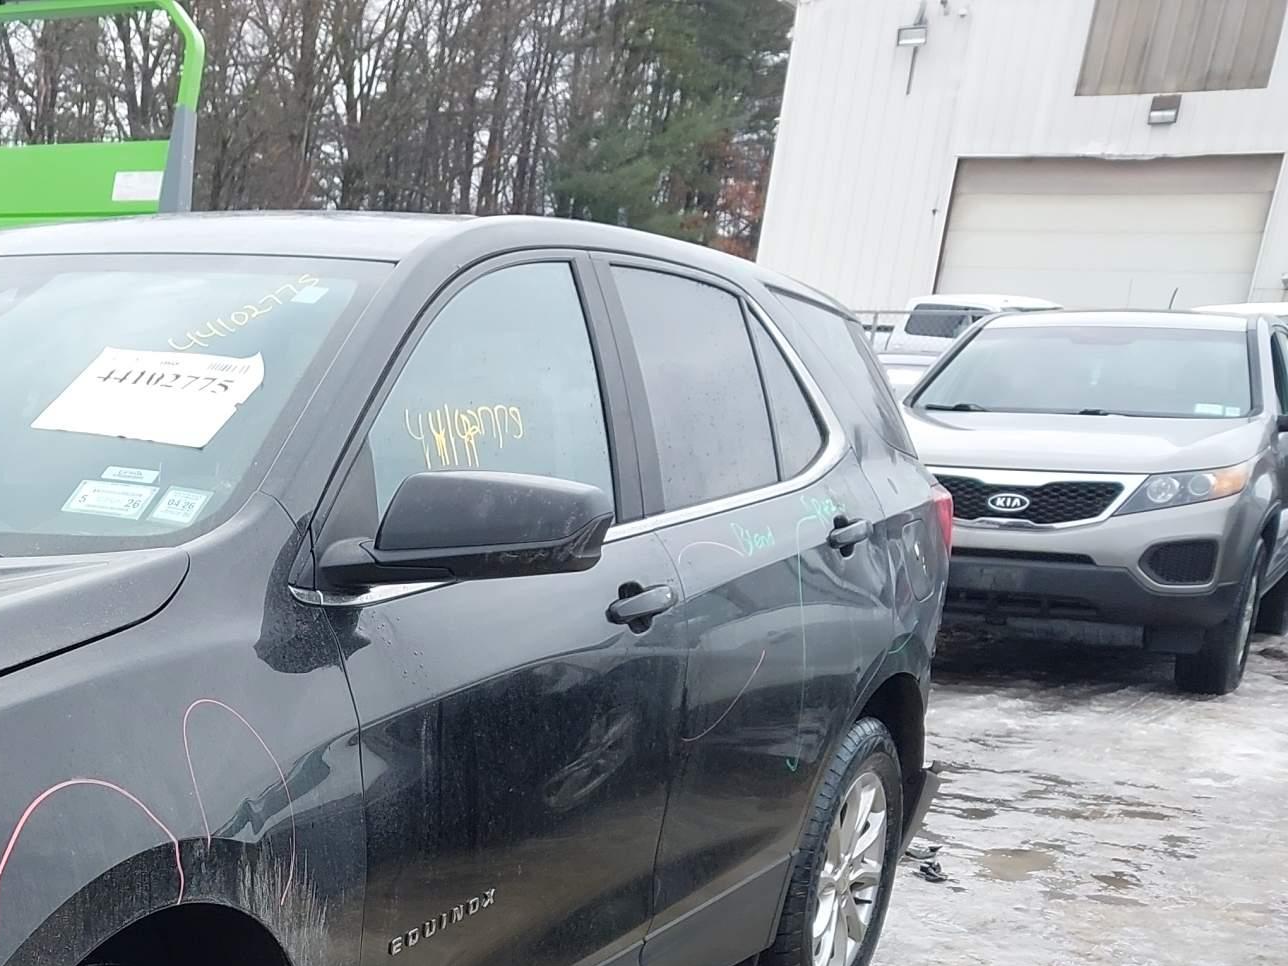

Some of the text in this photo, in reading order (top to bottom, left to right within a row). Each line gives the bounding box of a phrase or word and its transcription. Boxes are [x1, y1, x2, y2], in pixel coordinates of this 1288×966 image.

[167, 273, 320, 350] 44102775
[96, 368, 235, 394] 44102775
[124, 497, 141, 509] 26
[995, 497, 1021, 508] KIA
[388, 888, 496, 956] EQUINOX
